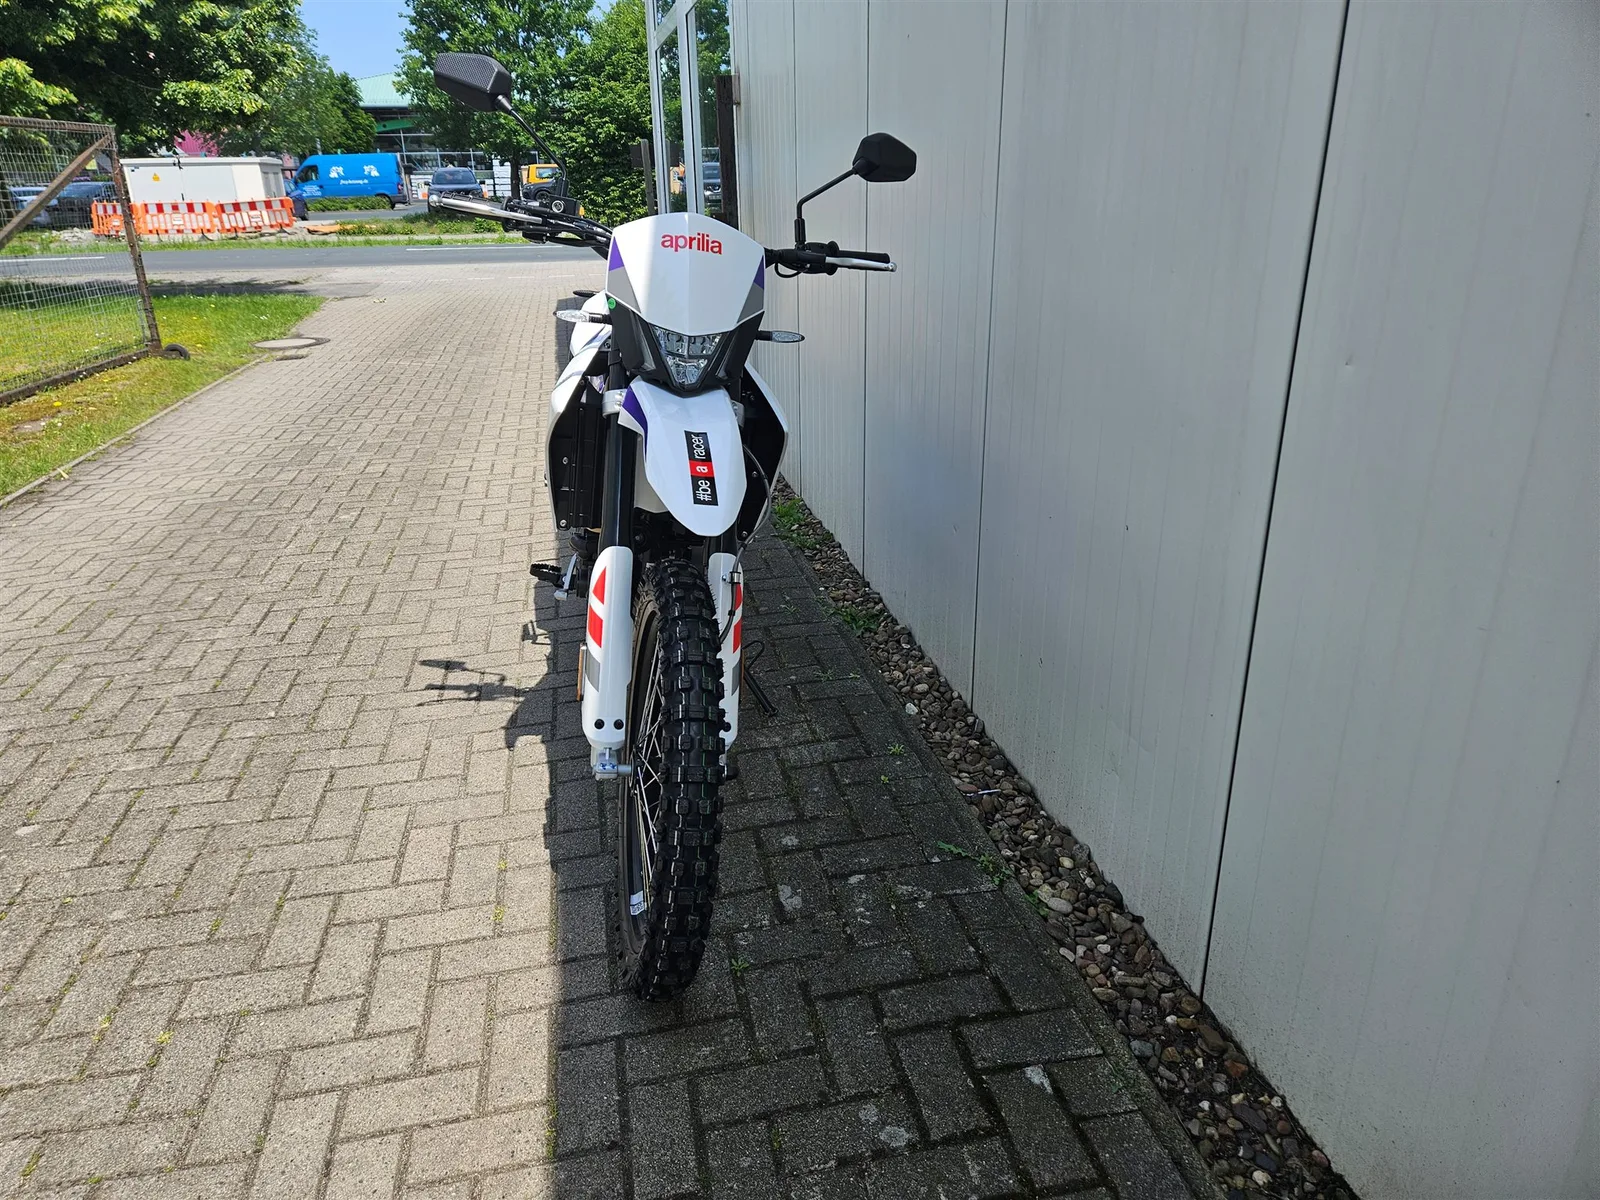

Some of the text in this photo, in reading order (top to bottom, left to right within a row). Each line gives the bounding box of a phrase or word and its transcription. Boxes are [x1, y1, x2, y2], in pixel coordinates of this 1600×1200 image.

[661, 232, 722, 255] aprilia
[691, 434, 712, 501] #be a racer
